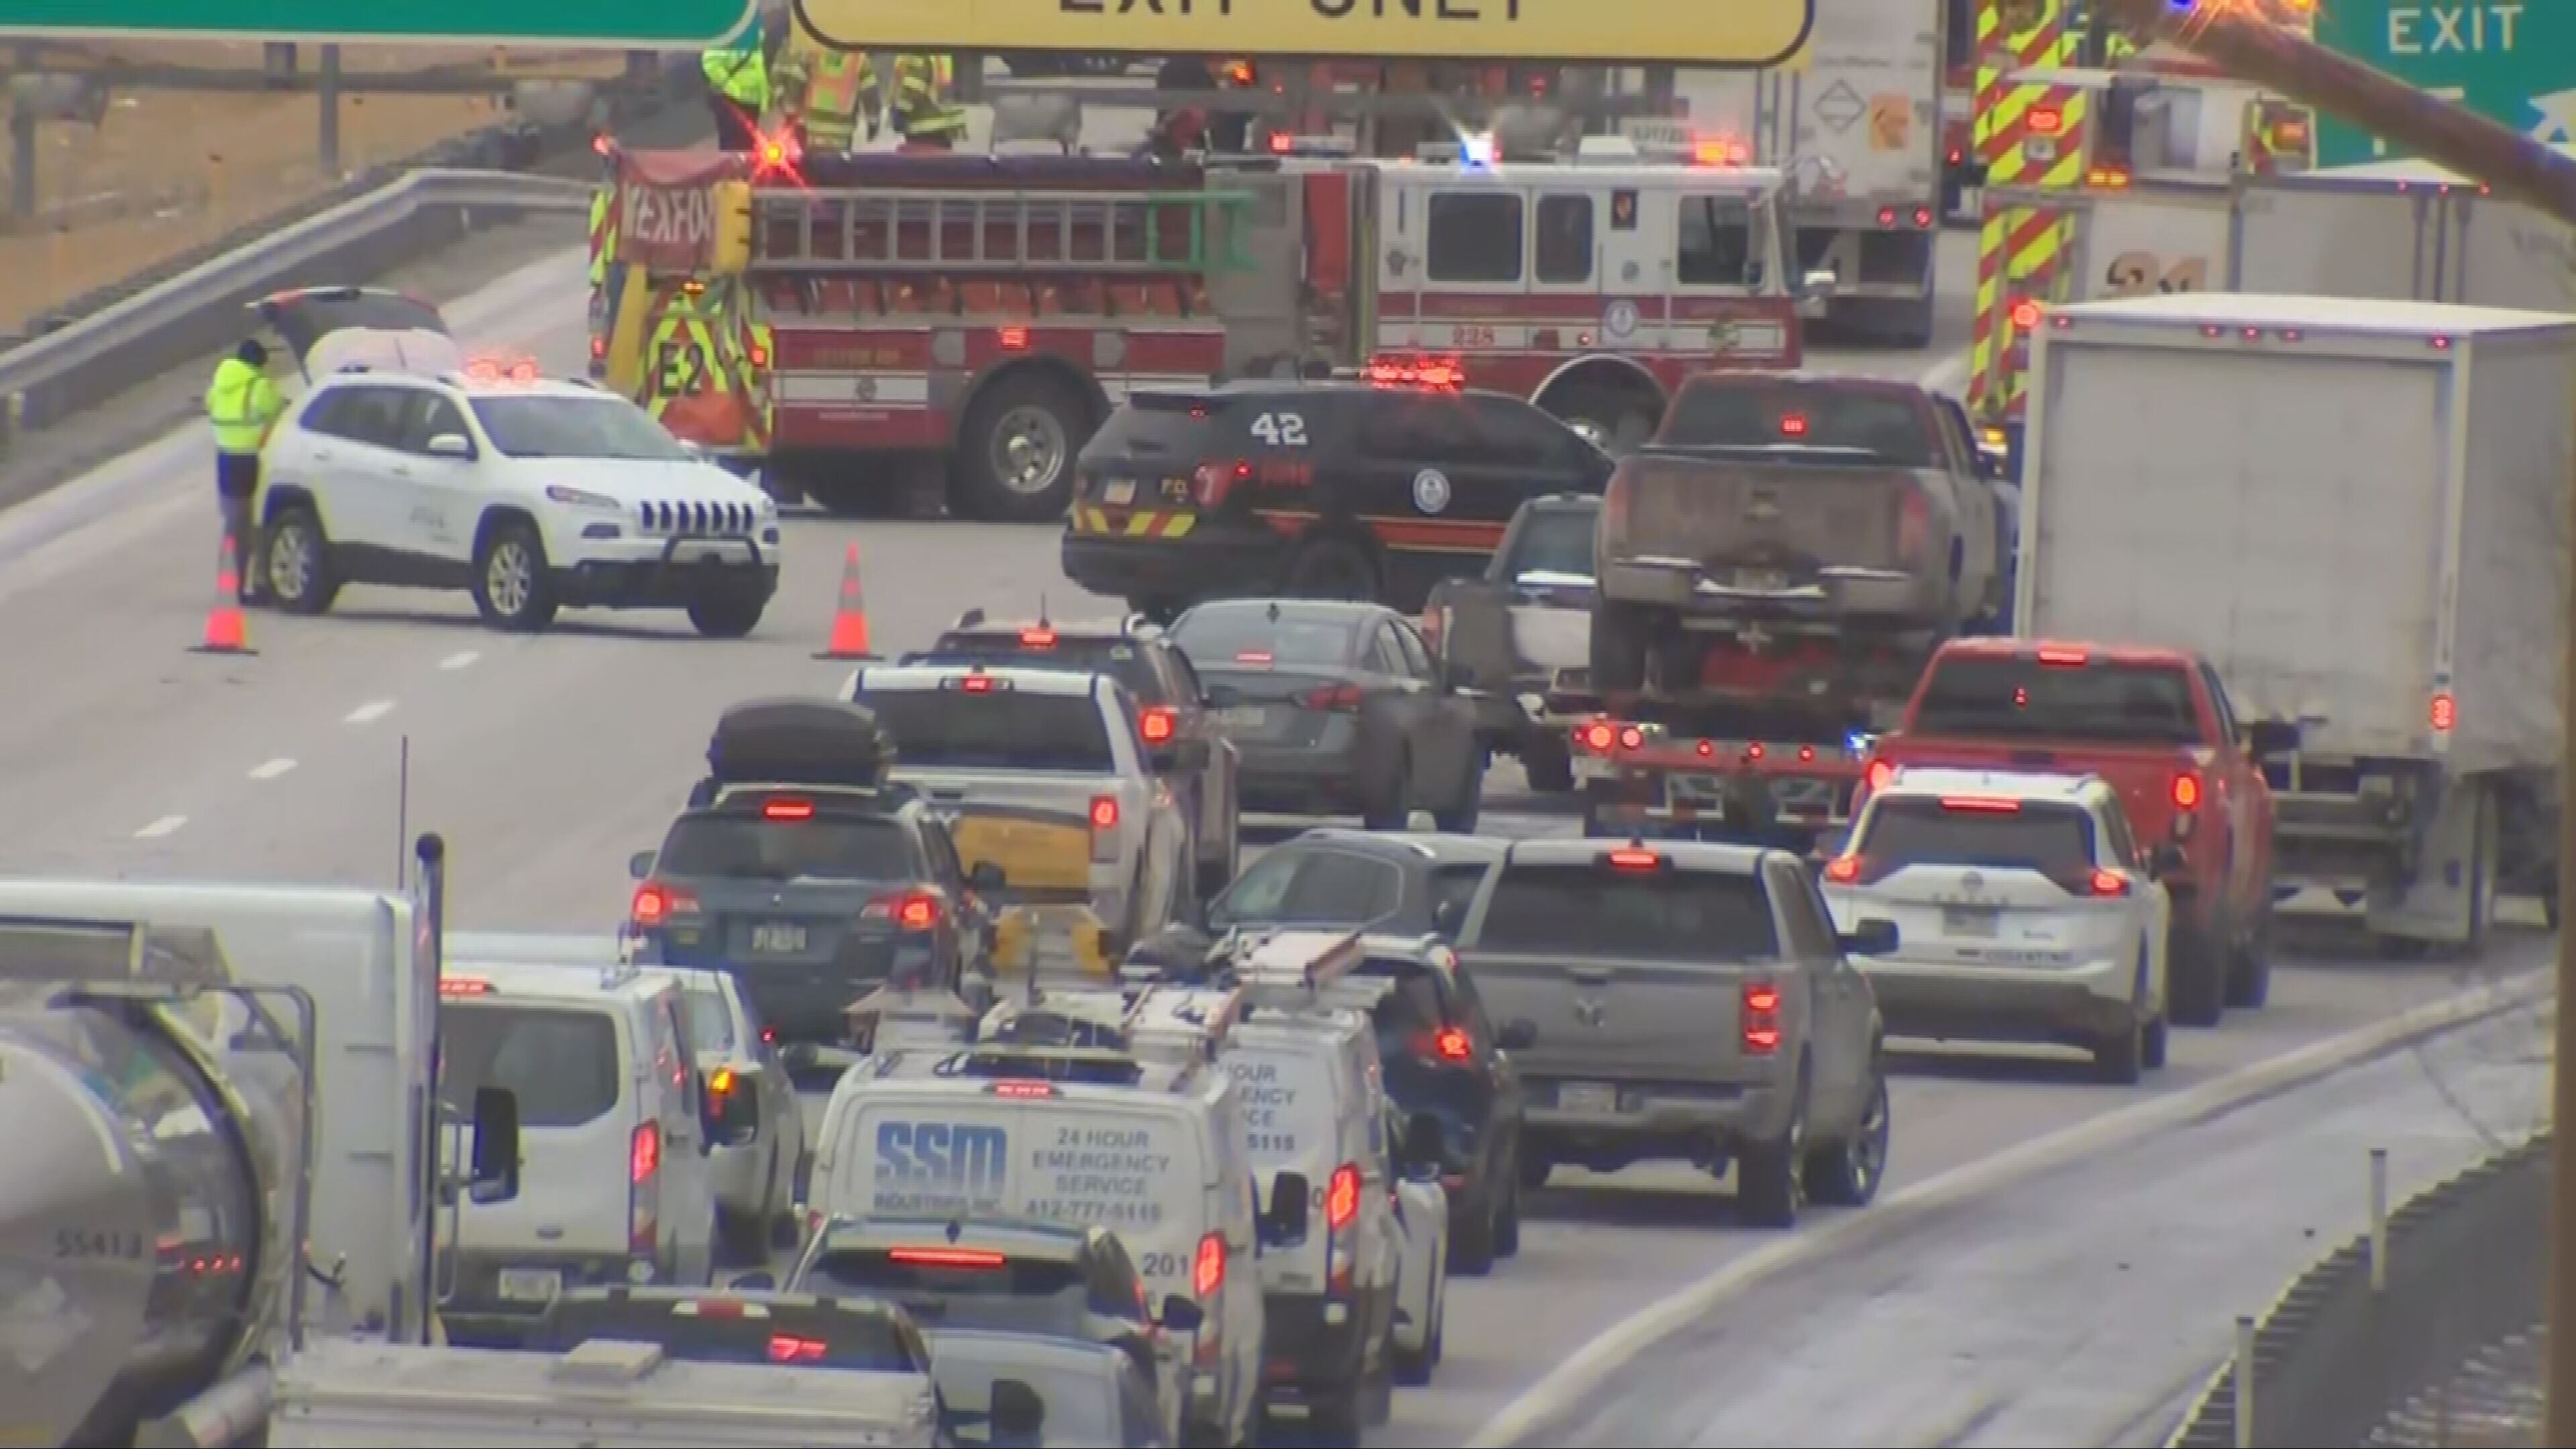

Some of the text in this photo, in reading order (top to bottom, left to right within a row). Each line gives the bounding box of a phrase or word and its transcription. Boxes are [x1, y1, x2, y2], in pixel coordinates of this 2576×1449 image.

[2388, 5, 2524, 54] EXIT
[659, 341, 703, 397] E2
[1250, 412, 1307, 445] 42
[1059, 1128, 1149, 1148] 24 HOUR
[1032, 1150, 1170, 1173] EMERGENCY
[1056, 1175, 1146, 1194] SERVICE
[1142, 1252, 1188, 1276] 201
